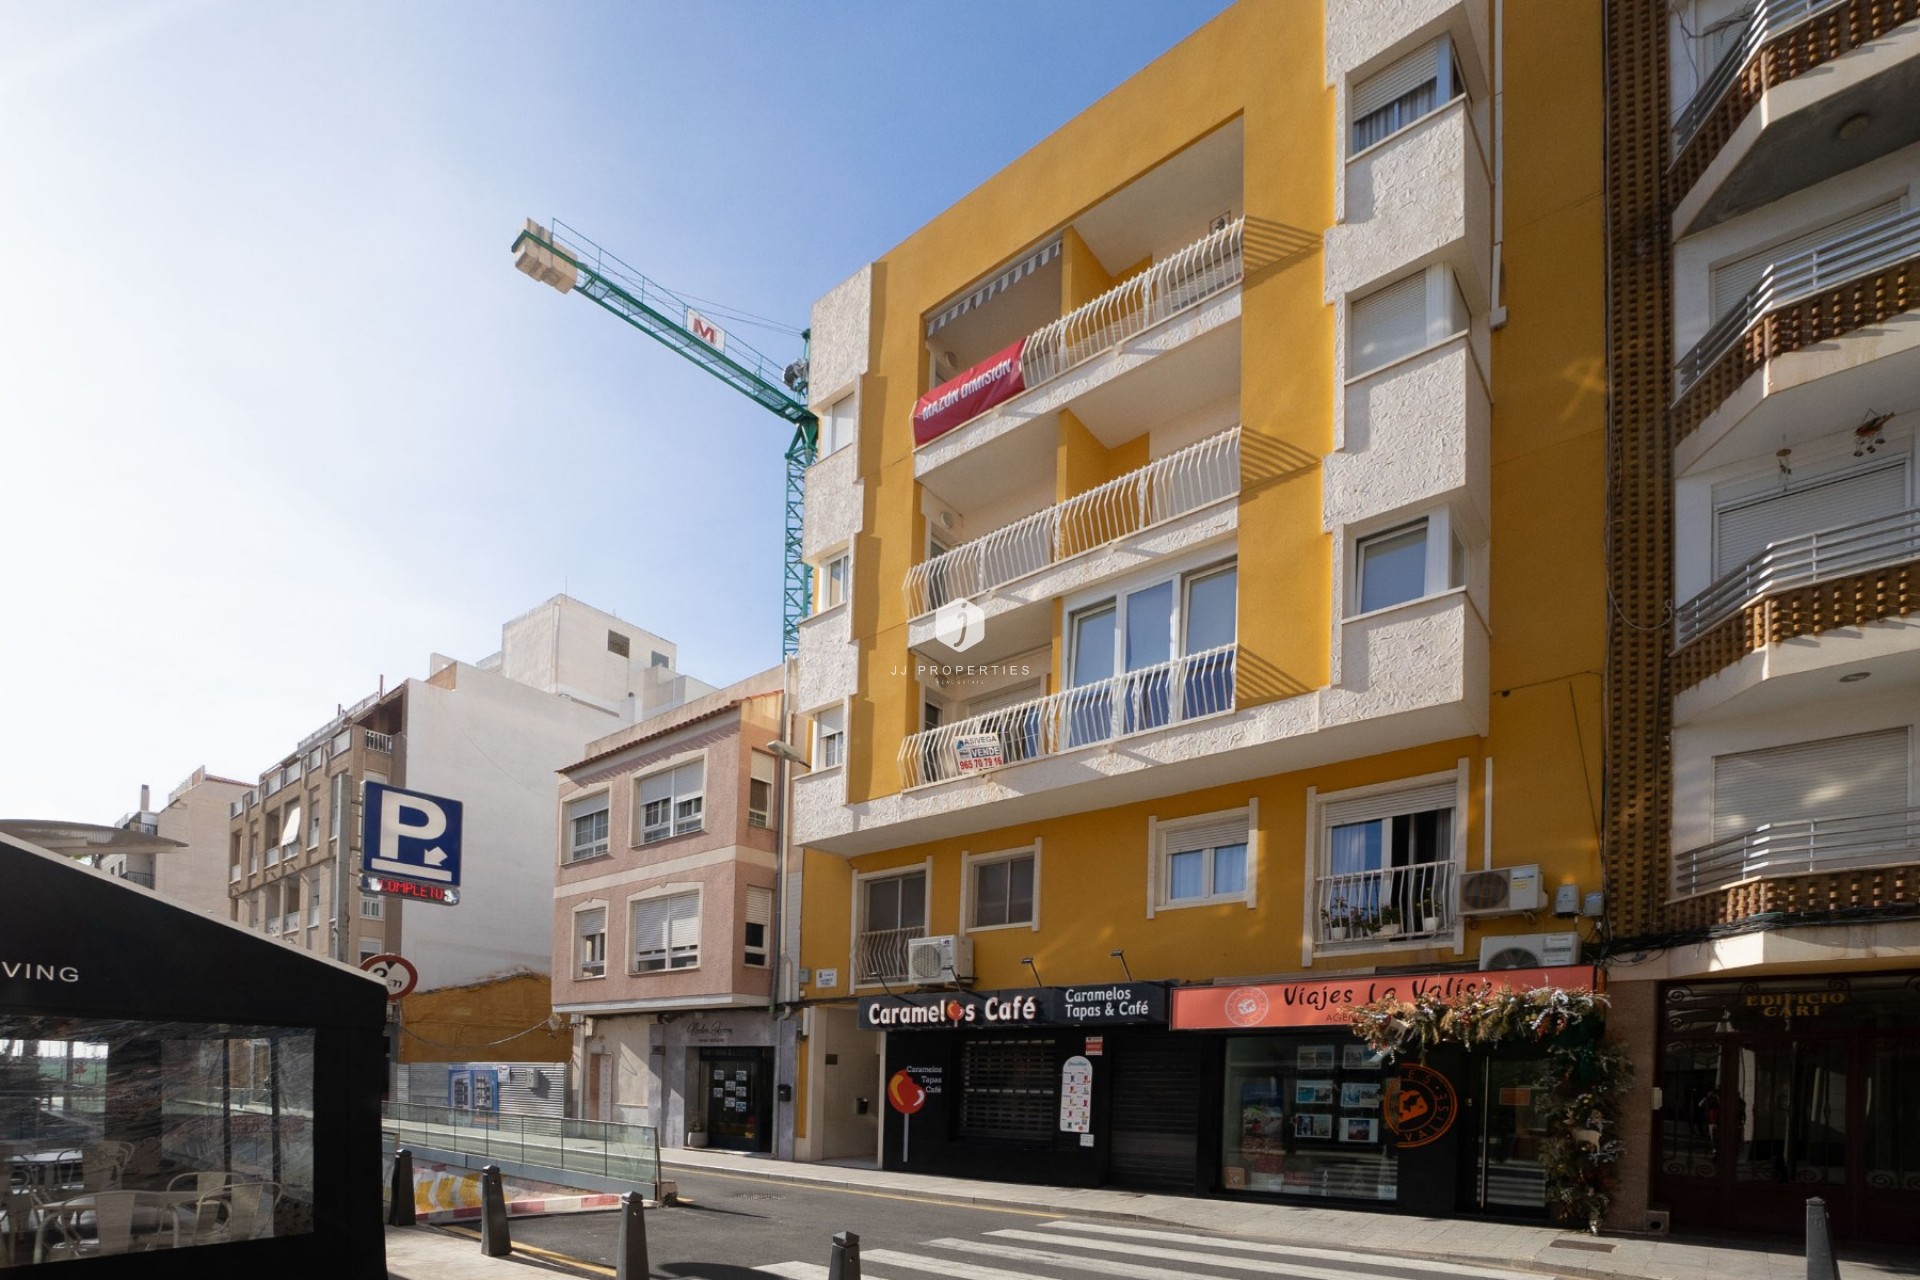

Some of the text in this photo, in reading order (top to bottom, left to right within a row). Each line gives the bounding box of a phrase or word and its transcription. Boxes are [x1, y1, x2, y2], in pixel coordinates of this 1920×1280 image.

[693, 318, 716, 344] M
[379, 789, 447, 860] P
[1, 961, 79, 983] VING
[1065, 986, 1131, 1003] Caramelos
[1284, 984, 1353, 1010] Viajes
[985, 995, 1036, 1021] Café
[1065, 1000, 1149, 1021] Tapas & Café
[921, 1075, 943, 1085] Tapas
